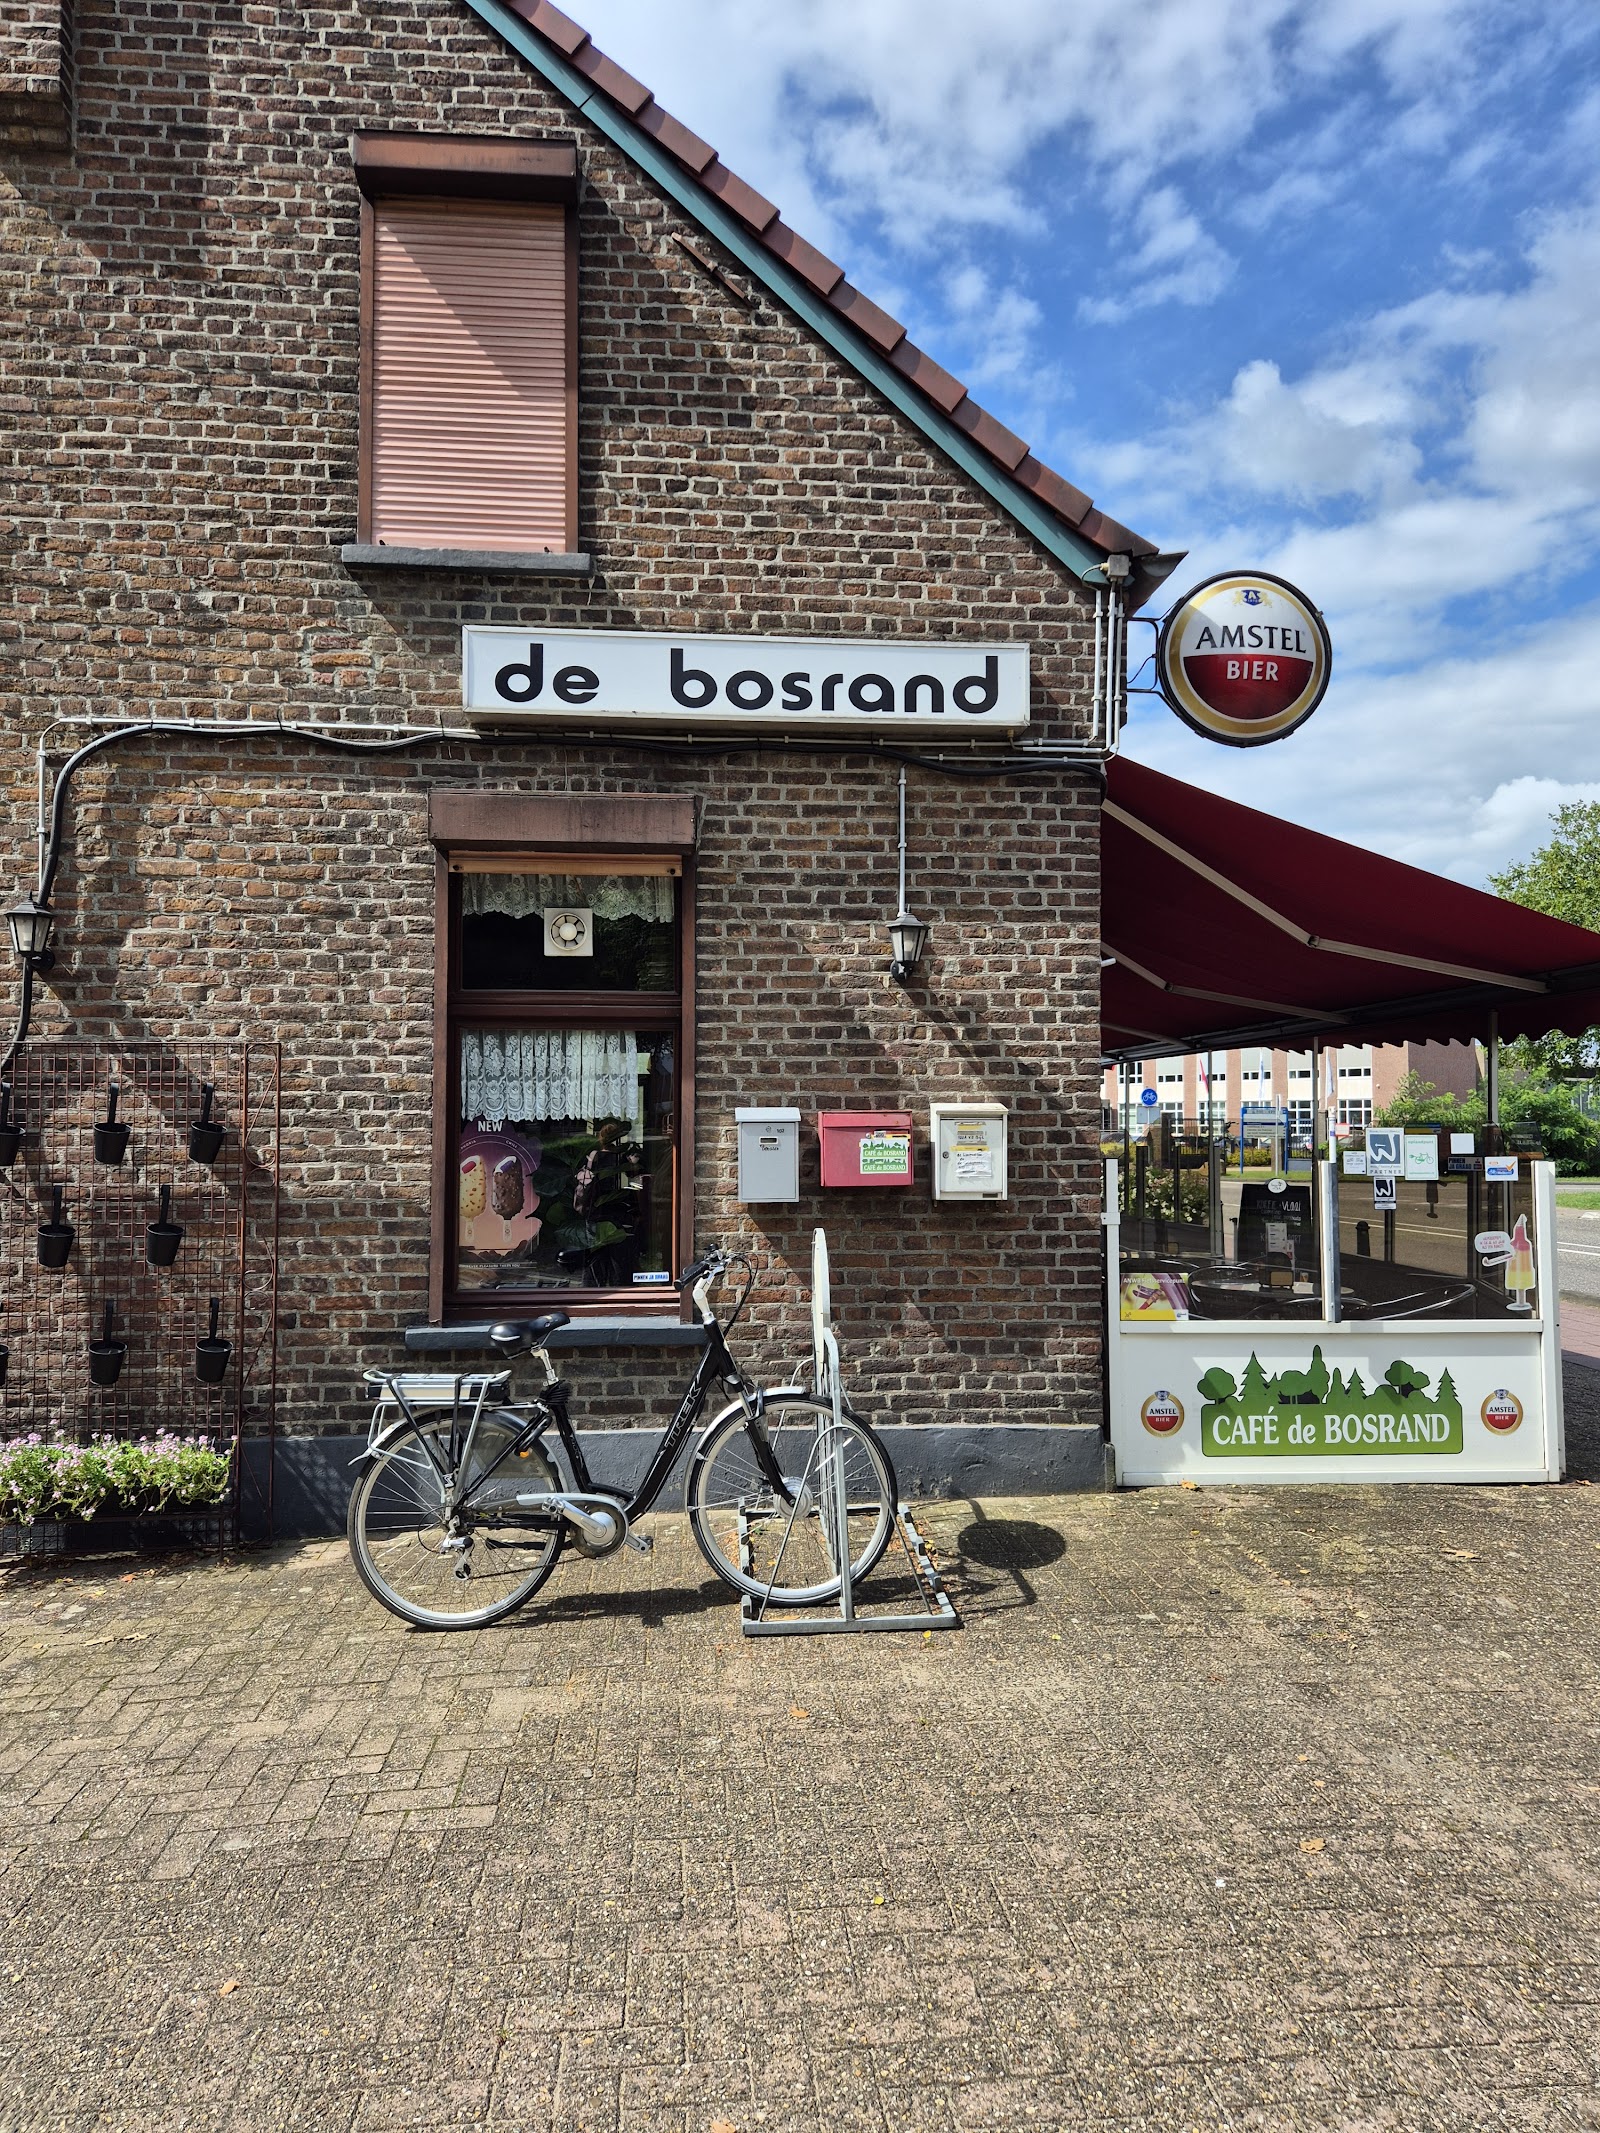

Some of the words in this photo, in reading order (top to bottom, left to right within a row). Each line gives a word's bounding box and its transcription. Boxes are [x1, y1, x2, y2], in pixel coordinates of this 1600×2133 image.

[1195, 625, 1306, 654] AMSTEL
[494, 642, 599, 704] de
[671, 647, 999, 715] bosrand
[1226, 660, 1279, 682] BIER
[478, 1120, 503, 1132] NEW
[664, 1381, 702, 1448] TREK
[1212, 1406, 1280, 1445] CAFÉ
[1287, 1414, 1316, 1444] de
[1324, 1413, 1450, 1444] BOSRAND
